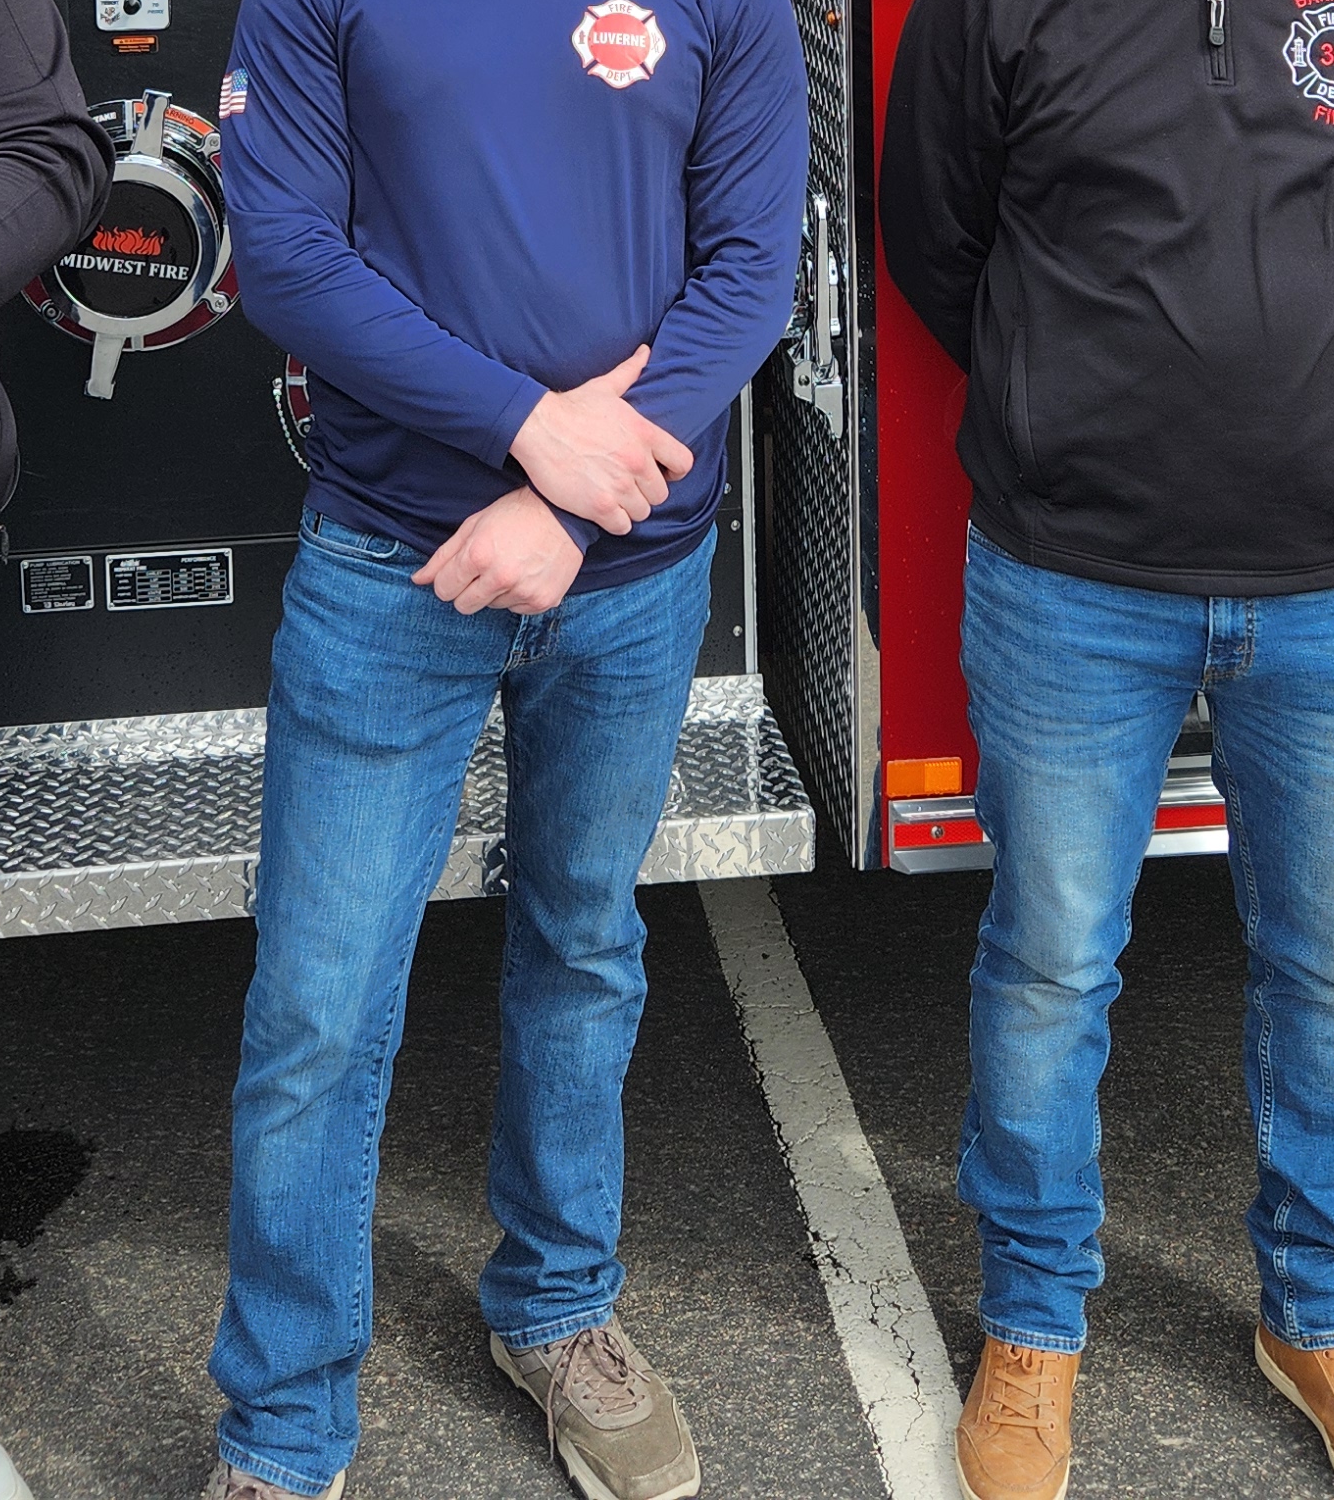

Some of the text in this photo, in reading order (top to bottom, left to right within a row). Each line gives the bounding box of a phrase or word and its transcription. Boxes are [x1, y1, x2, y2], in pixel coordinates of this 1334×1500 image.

[608, 3, 634, 14] FIRE
[592, 32, 647, 48] LUVERNE
[165, 108, 195, 125] ARNING
[59, 253, 190, 281] MIDWEST FIRE
